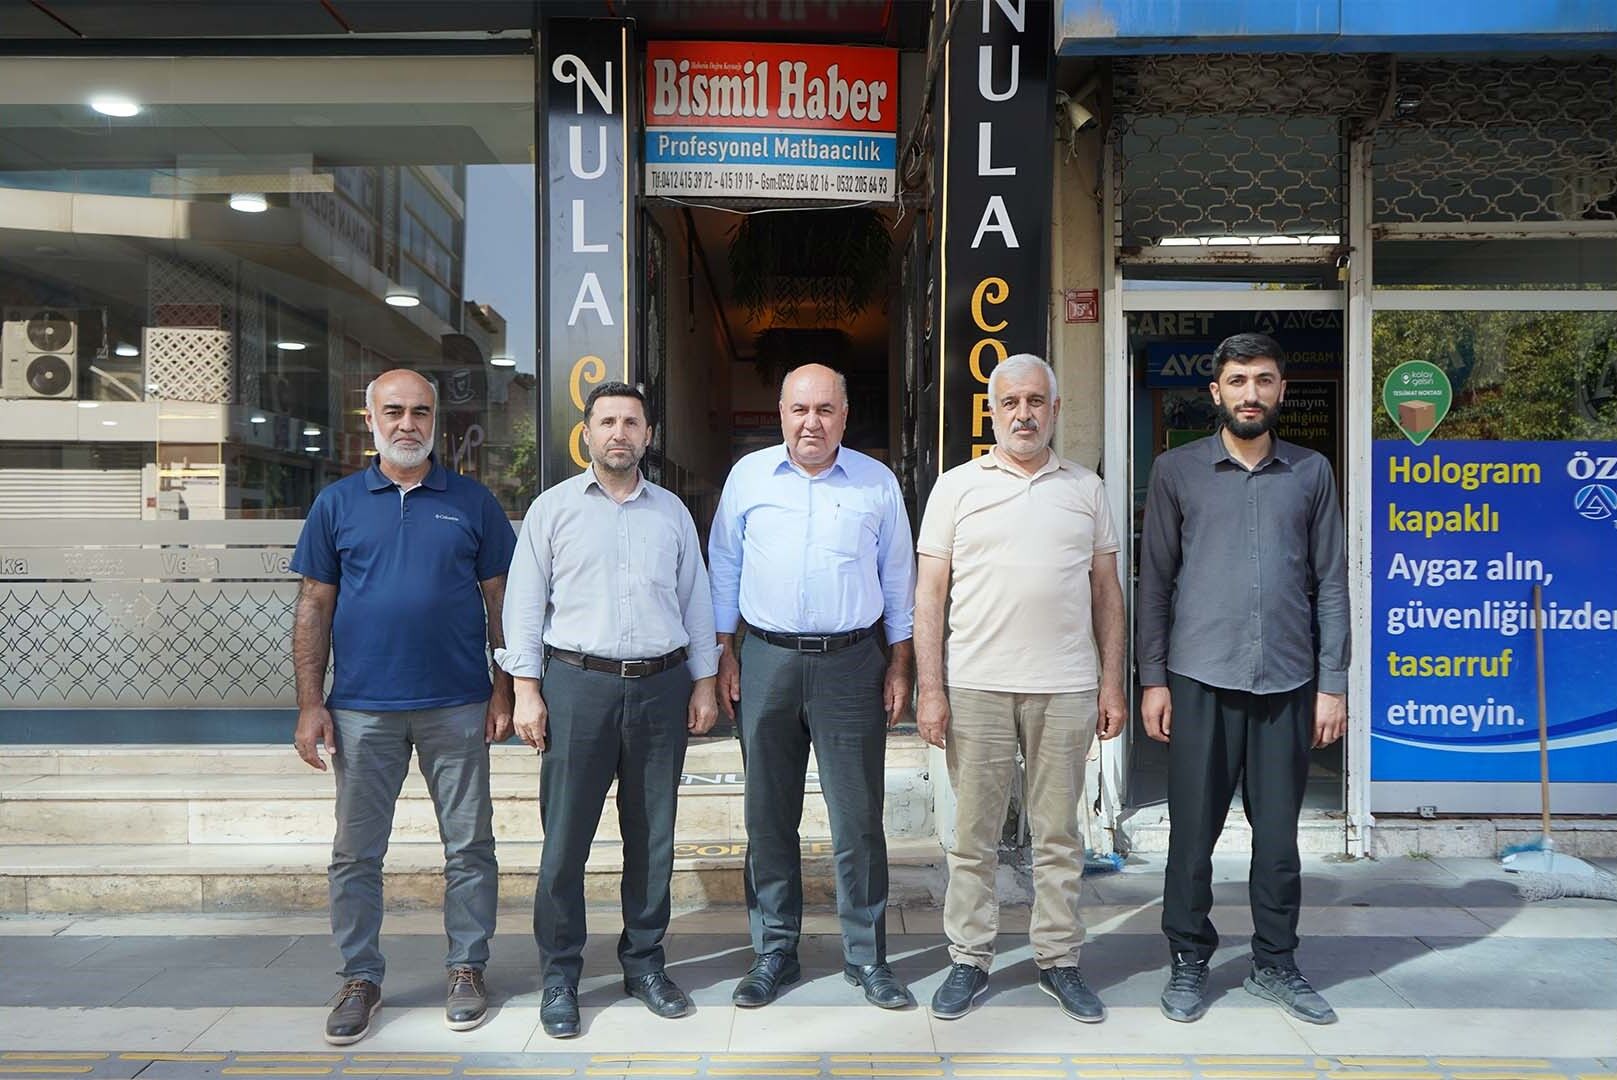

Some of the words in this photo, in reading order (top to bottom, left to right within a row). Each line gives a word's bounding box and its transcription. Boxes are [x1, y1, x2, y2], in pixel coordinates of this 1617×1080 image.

[653, 59, 769, 118] Bismil
[777, 60, 888, 122] Haber
[970, 0, 1027, 249] NULA
[659, 135, 769, 162] Profesyonel
[774, 137, 881, 161] Matbaacılık
[552, 54, 614, 326] NULA
[680, 171, 693, 189] 415
[693, 171, 703, 189] 39
[704, 172, 713, 189] 72
[720, 172, 733, 189] 415
[735, 172, 743, 190] 19
[745, 172, 753, 190] 19
[761, 172, 795, 190] Gsm:0532
[821, 174, 829, 192] 16
[836, 175, 853, 193] 0532
[878, 177, 888, 194] 93
[1281, 351, 1334, 363] LOGRAM
[1389, 454, 1541, 490] Hologram
[1388, 502, 1499, 538] kapaklı
[1387, 552, 1478, 587] Aygaz
[1486, 551, 1553, 586] alın,
[1387, 600, 1617, 636] güvenliğinizde
[1387, 649, 1513, 677] tasarruf
[1387, 698, 1525, 732] etmeyin.
